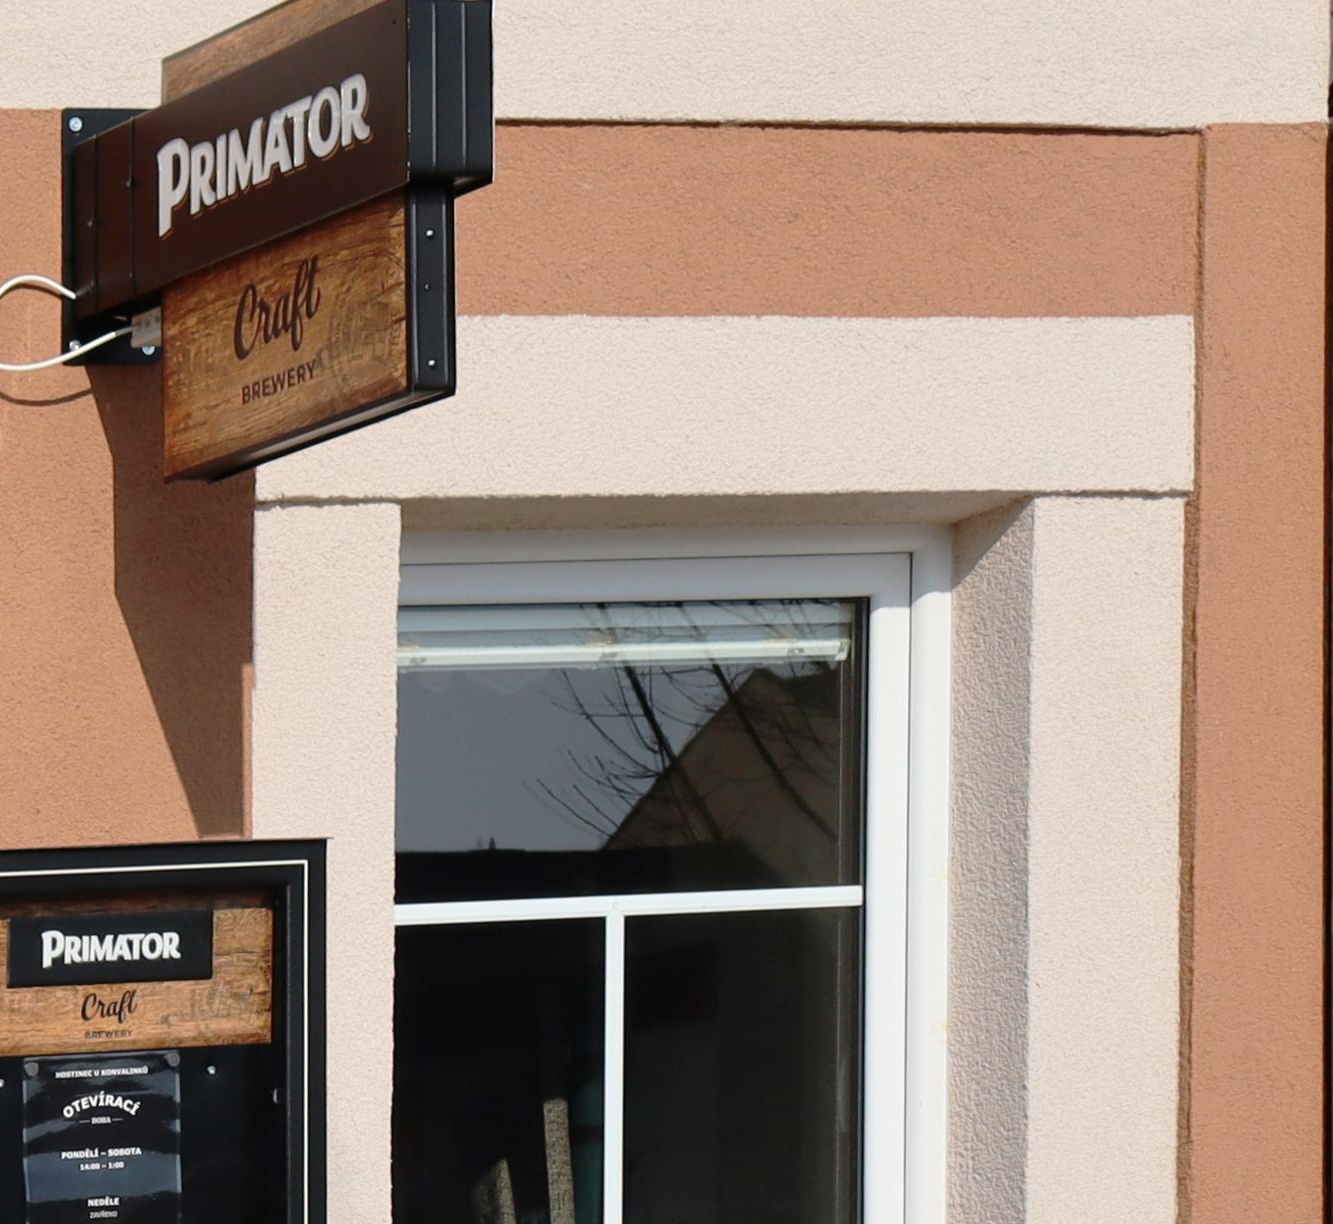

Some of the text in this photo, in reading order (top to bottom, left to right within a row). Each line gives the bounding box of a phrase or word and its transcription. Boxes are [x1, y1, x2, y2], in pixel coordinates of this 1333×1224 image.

[157, 73, 371, 237] PRIMATOR
[233, 254, 321, 361] Craft
[241, 359, 316, 405] BREWERY
[41, 930, 182, 969] PRIMATOR
[81, 989, 138, 1024] Craft
[55, 1069, 93, 1078] HOSTINEC
[94, 1069, 100, 1077] U
[63, 1090, 141, 1118] OTEVÍRACÍ
[61, 1147, 100, 1160] PONDĚLÍ
[107, 1147, 142, 1157] SOBOTA
[87, 1195, 120, 1207] NEDĚLE
